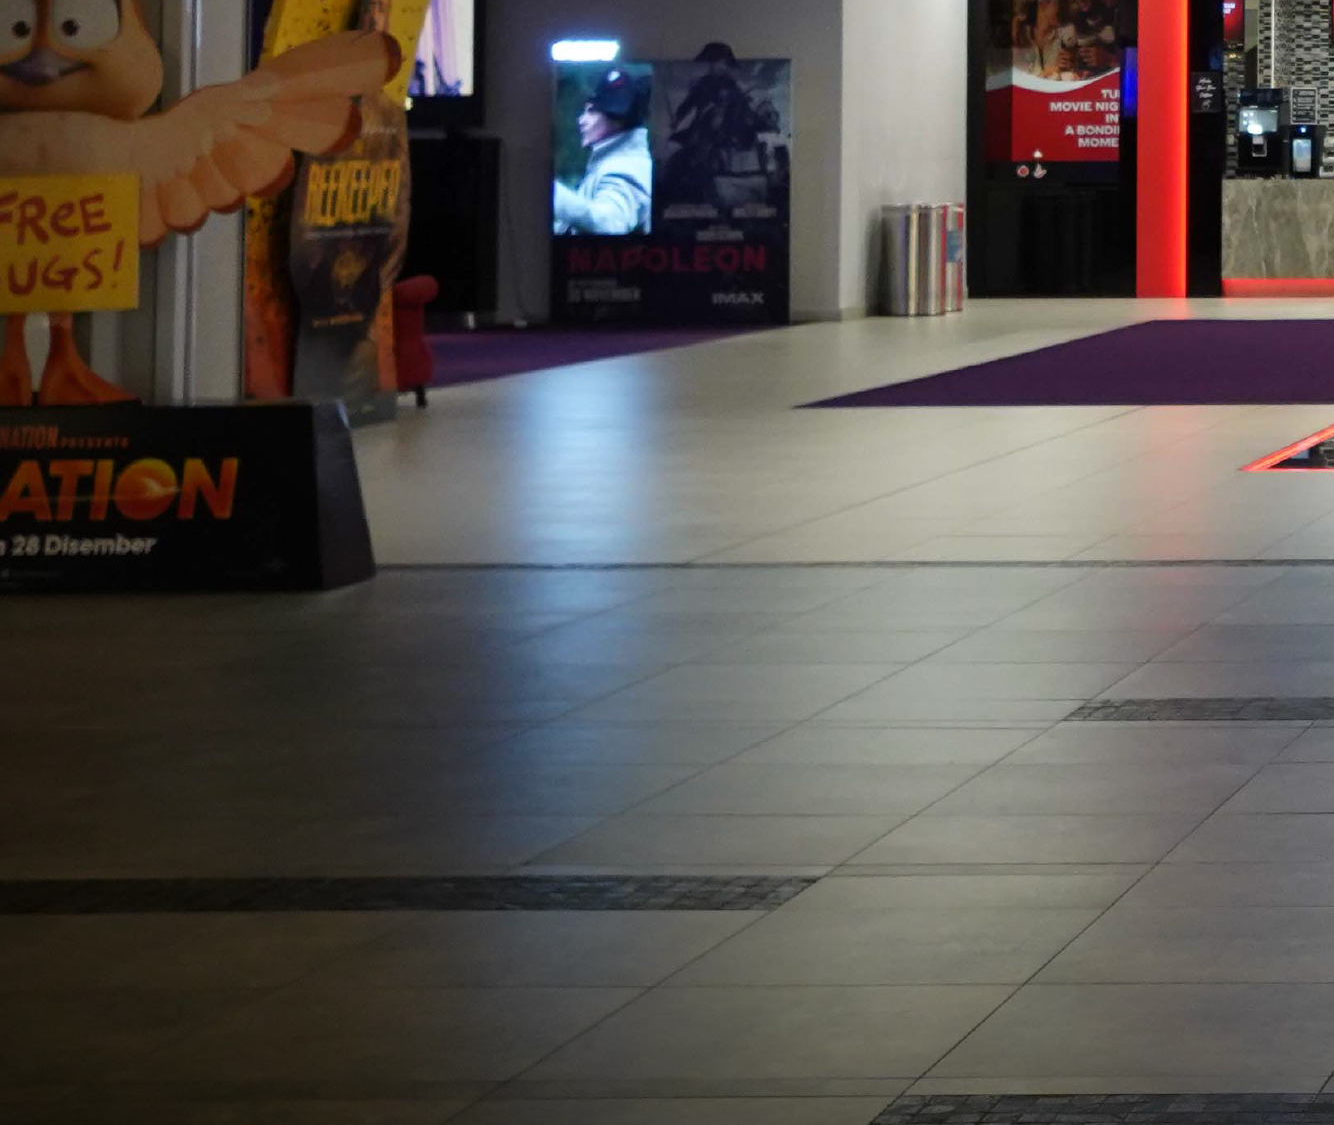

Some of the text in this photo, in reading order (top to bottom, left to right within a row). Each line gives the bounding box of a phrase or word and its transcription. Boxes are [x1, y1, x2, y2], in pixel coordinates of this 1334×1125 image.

[1050, 101, 1092, 112] MOVIE
[1065, 125, 1074, 136] A
[568, 245, 767, 274] NAPOLEON
[712, 292, 764, 305] IMAX
[61, 437, 130, 449] PRESENTS
[12, 534, 40, 557] 28
[45, 533, 158, 557] Disember
